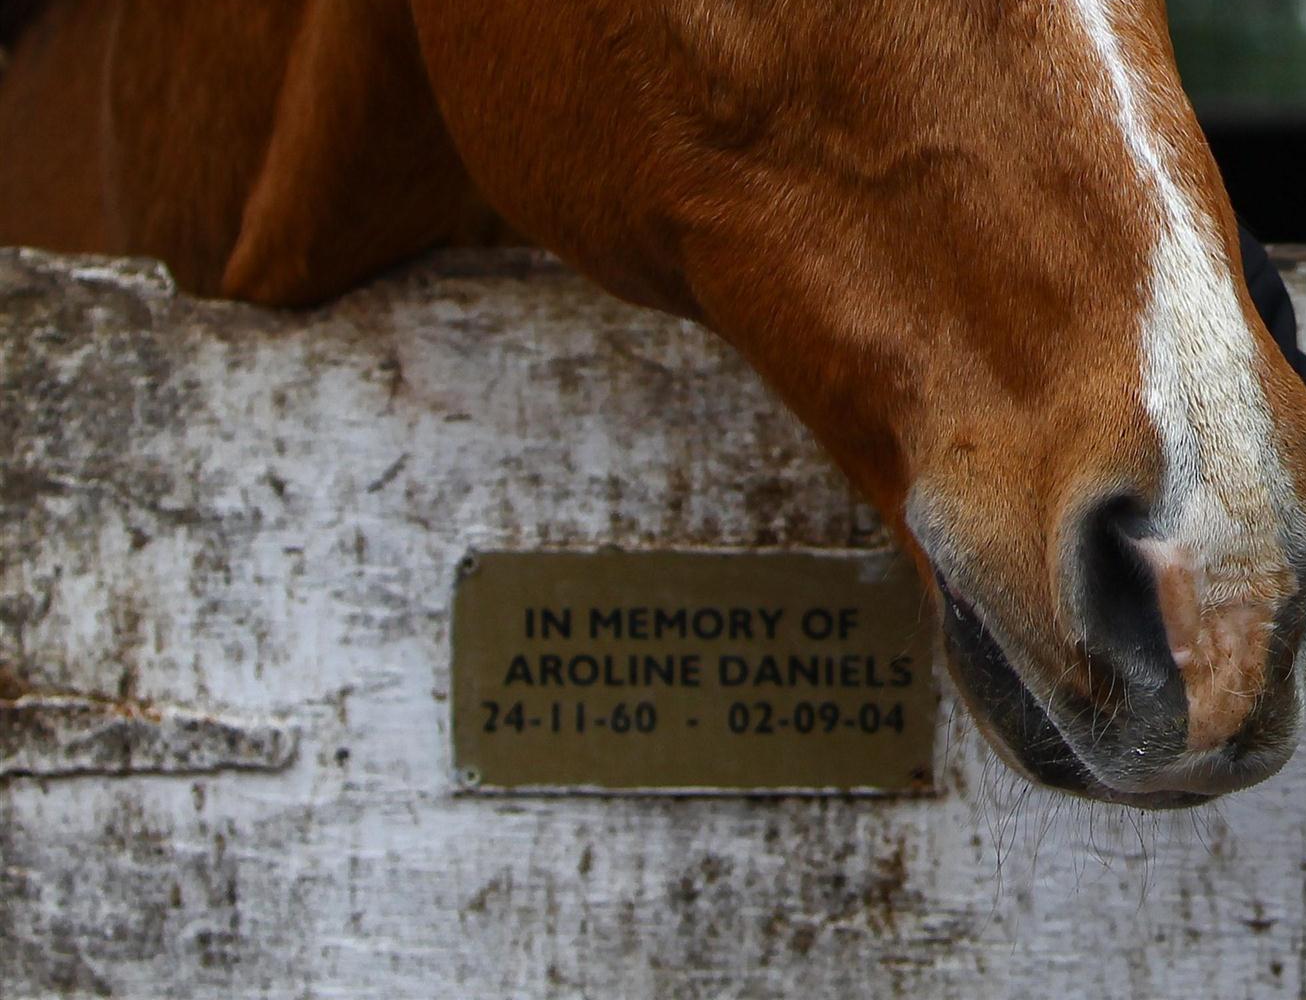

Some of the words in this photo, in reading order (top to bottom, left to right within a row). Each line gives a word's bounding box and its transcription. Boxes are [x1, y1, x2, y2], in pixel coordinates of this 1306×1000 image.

[525, 607, 571, 639] IN
[588, 607, 784, 641] MEMORY
[801, 607, 859, 641] OF
[503, 654, 701, 688] AROLINE
[719, 656, 914, 687] DANIELS
[481, 701, 658, 734] 24-11-60
[686, 717, 699, 728] -
[728, 702, 905, 734] 02-09-04
